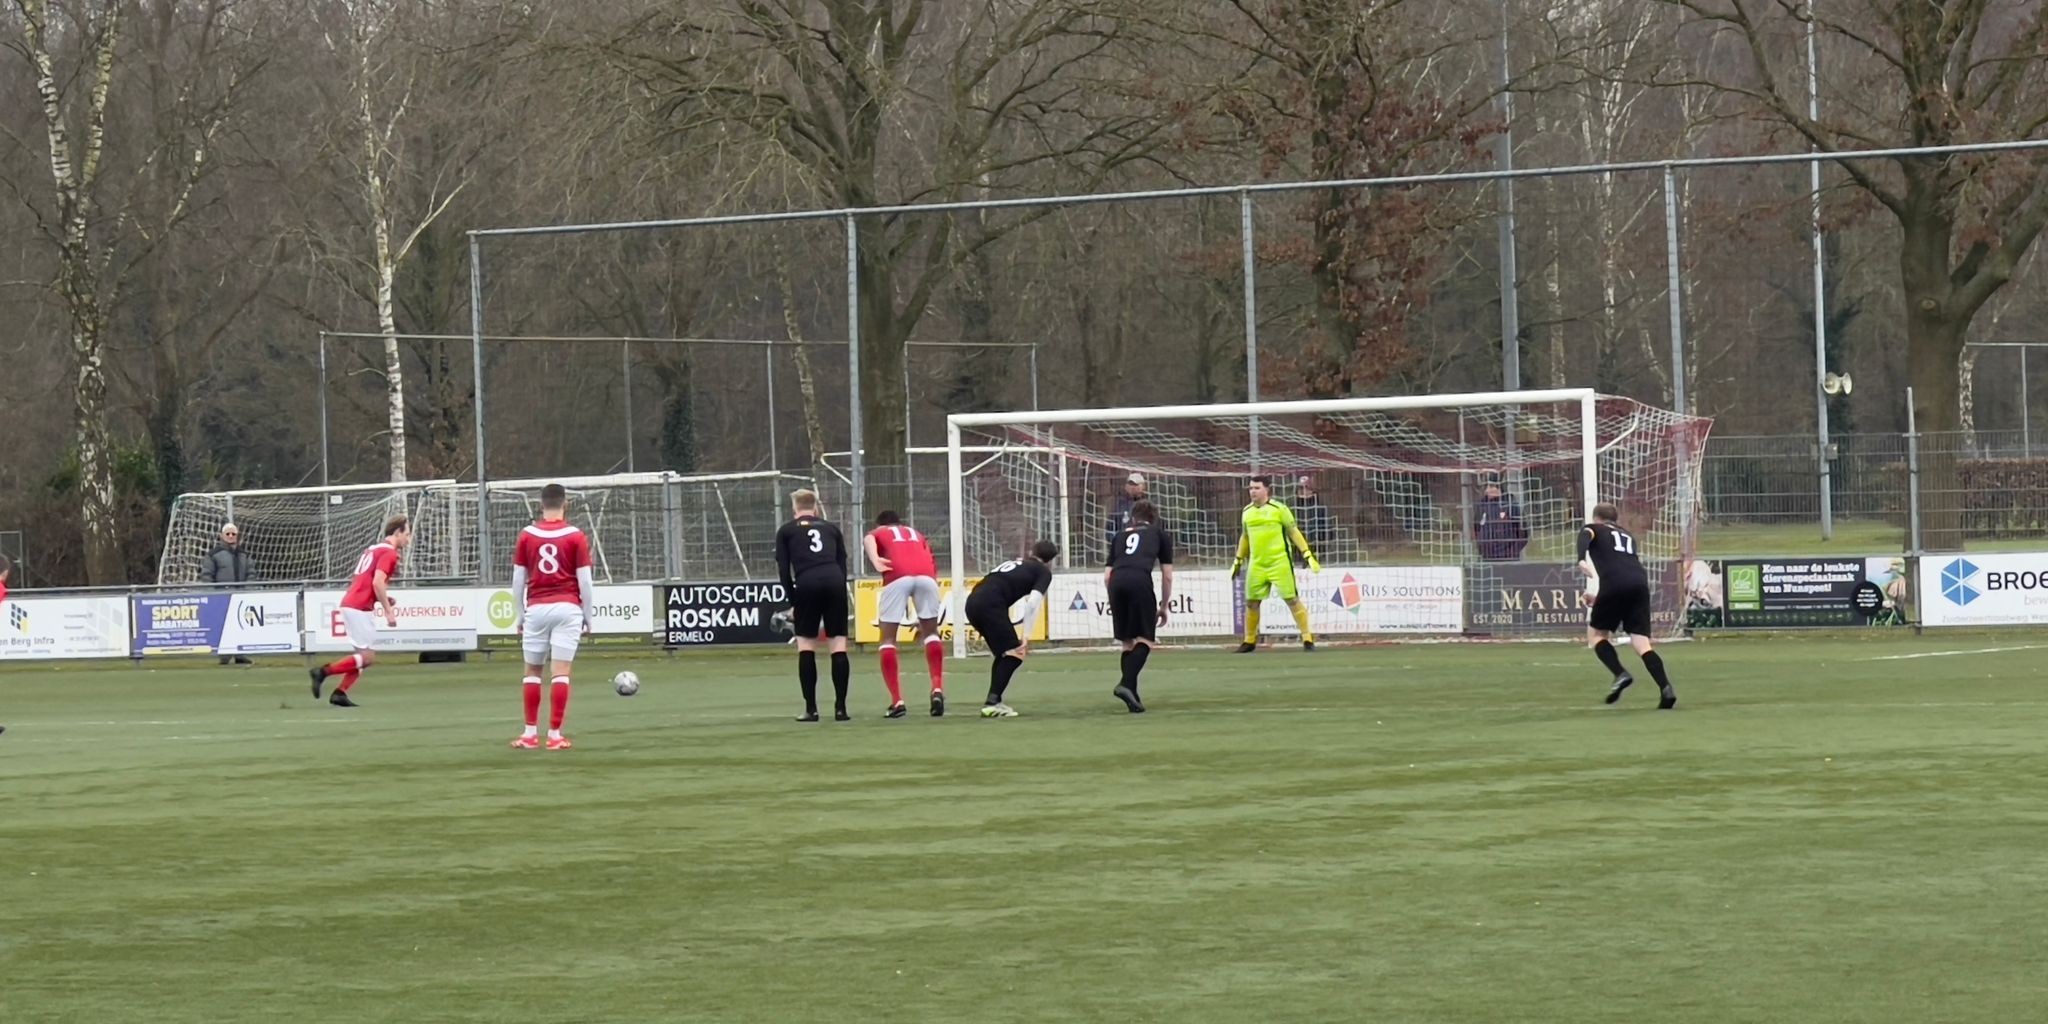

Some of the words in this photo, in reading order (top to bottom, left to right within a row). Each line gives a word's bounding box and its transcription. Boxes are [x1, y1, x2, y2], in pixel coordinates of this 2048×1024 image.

[807, 529, 823, 553] 3
[888, 526, 919, 542] 11
[1125, 533, 1140, 554] 9
[1611, 531, 1633, 554] 17
[538, 543, 559, 574] 8
[1762, 564, 1785, 574] Kom
[1786, 565, 1809, 573] naar
[1810, 563, 1823, 573] de
[668, 584, 789, 605] AUTOSCHAD.
[1762, 585, 1781, 593] van
[152, 605, 199, 620] SPORT
[449, 606, 464, 617] BV
[490, 601, 514, 619] GB
[592, 603, 640, 620] ontage
[152, 619, 200, 629] MARATHON
[668, 607, 760, 629] ROSKAM
[1473, 614, 1489, 624] EST
[1536, 612, 1587, 624] RESTAUR
[11, 637, 31, 647] Berg
[34, 636, 55, 645] Infra
[668, 630, 714, 643] ERMELO
